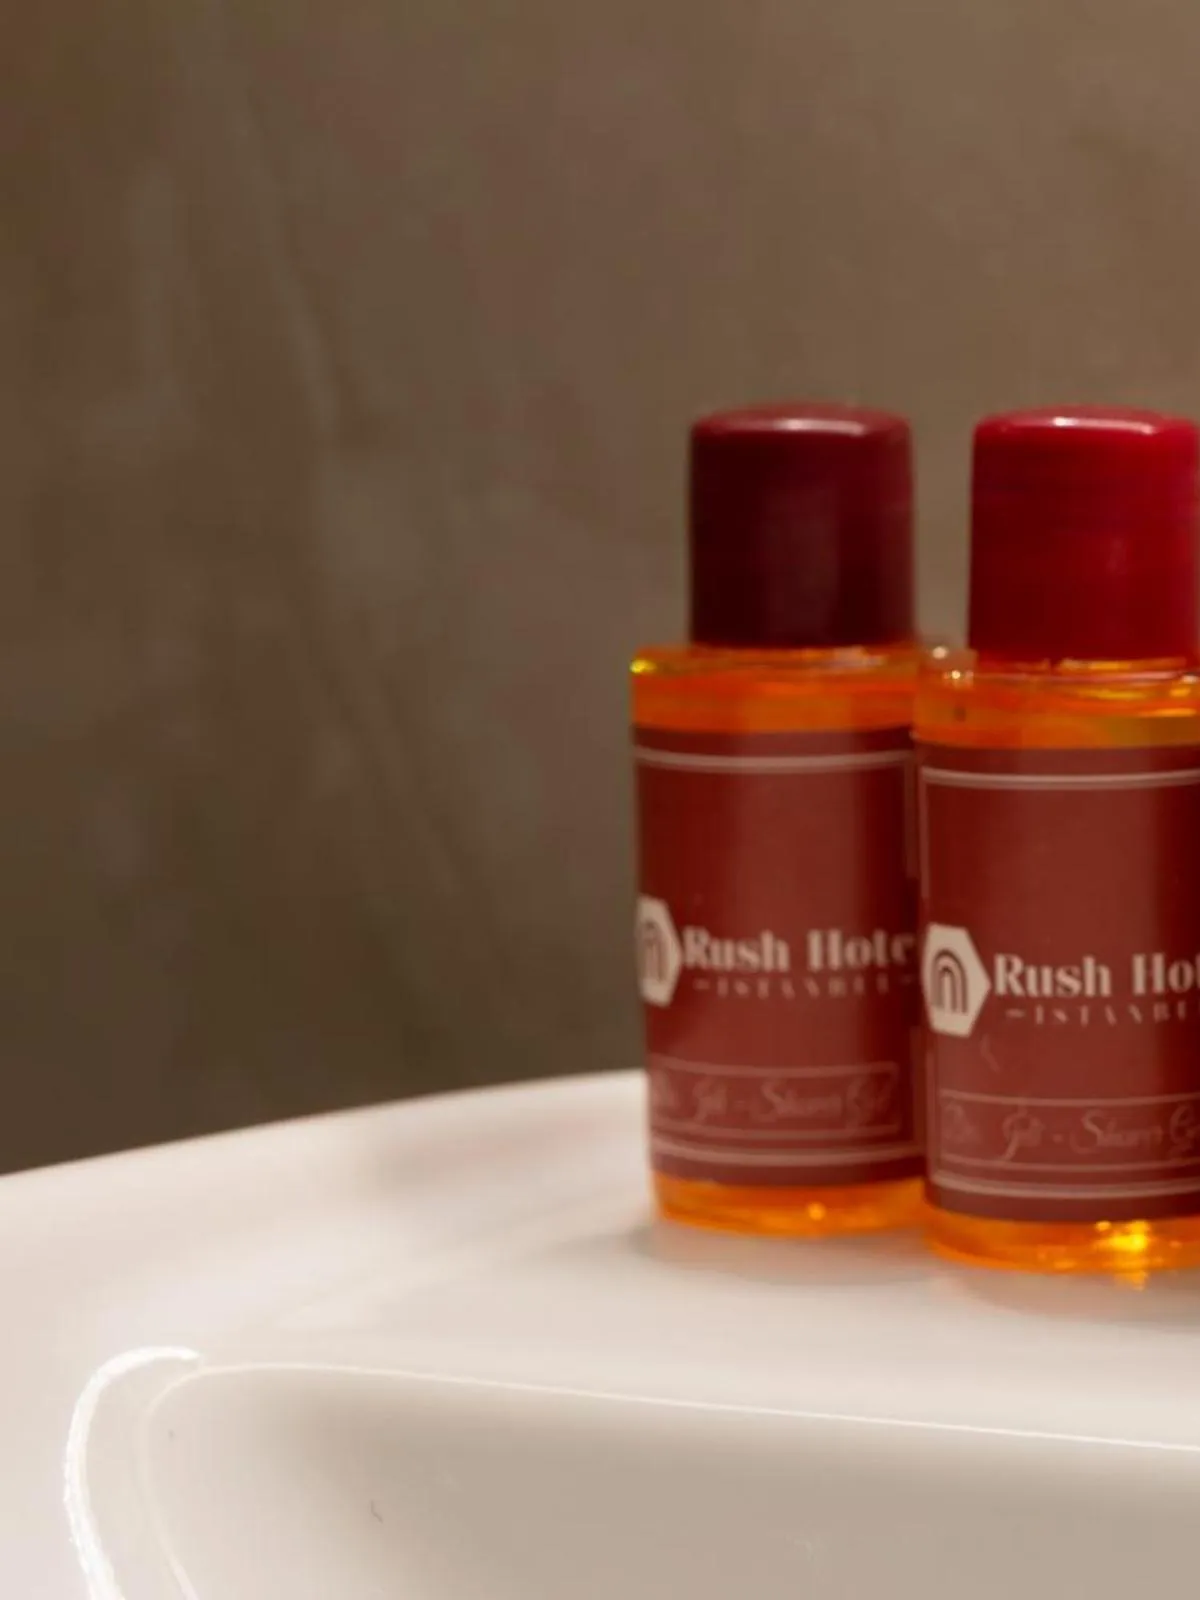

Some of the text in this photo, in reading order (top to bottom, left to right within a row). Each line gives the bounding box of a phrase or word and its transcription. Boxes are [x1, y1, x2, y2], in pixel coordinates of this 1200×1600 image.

[683, 924, 914, 973] Rush Hote
[994, 953, 1112, 998] Rush
